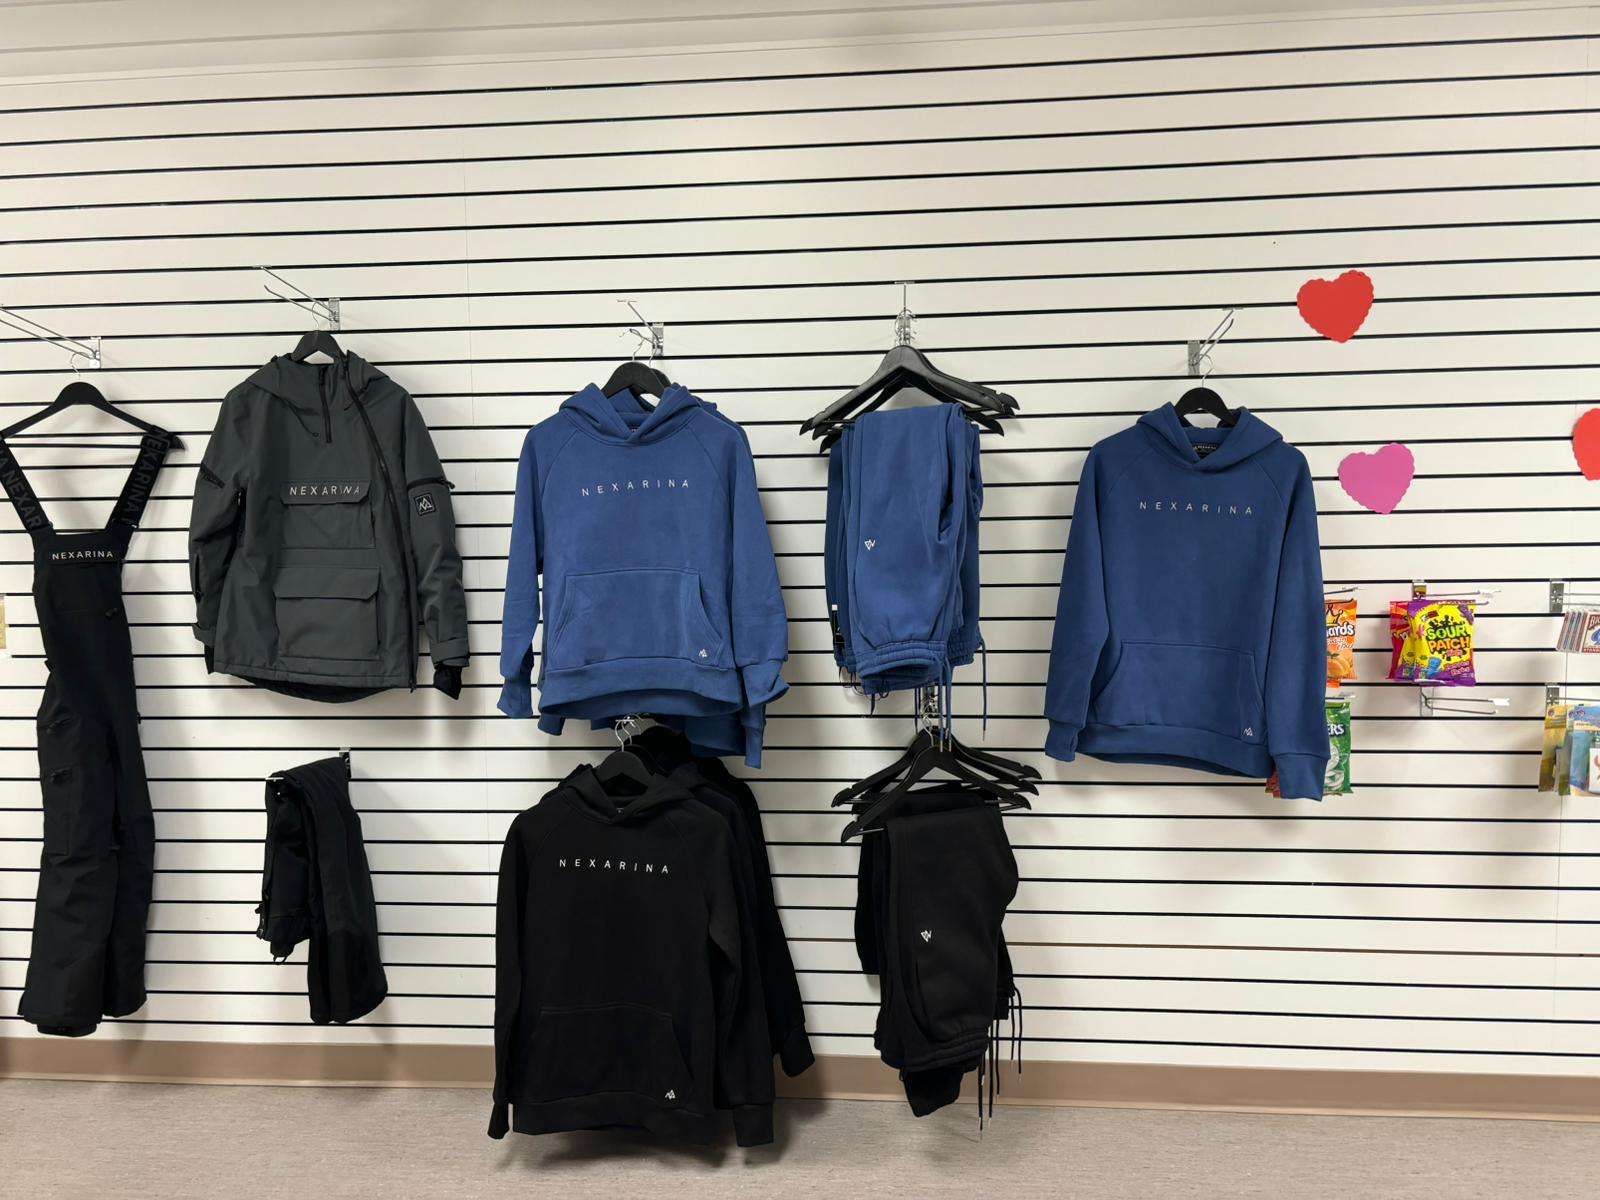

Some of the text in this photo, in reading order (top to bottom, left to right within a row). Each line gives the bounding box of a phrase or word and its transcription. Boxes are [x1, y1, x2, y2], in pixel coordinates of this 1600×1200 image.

[289, 485, 360, 496] NEXARINA
[581, 479, 689, 497] NEXARINA
[1139, 501, 1252, 515] NEXARINA
[52, 550, 113, 560] NEXARINA
[1427, 624, 1467, 641] SOUR
[1428, 636, 1470, 653] PATCH
[559, 858, 669, 874] NEXARINA
